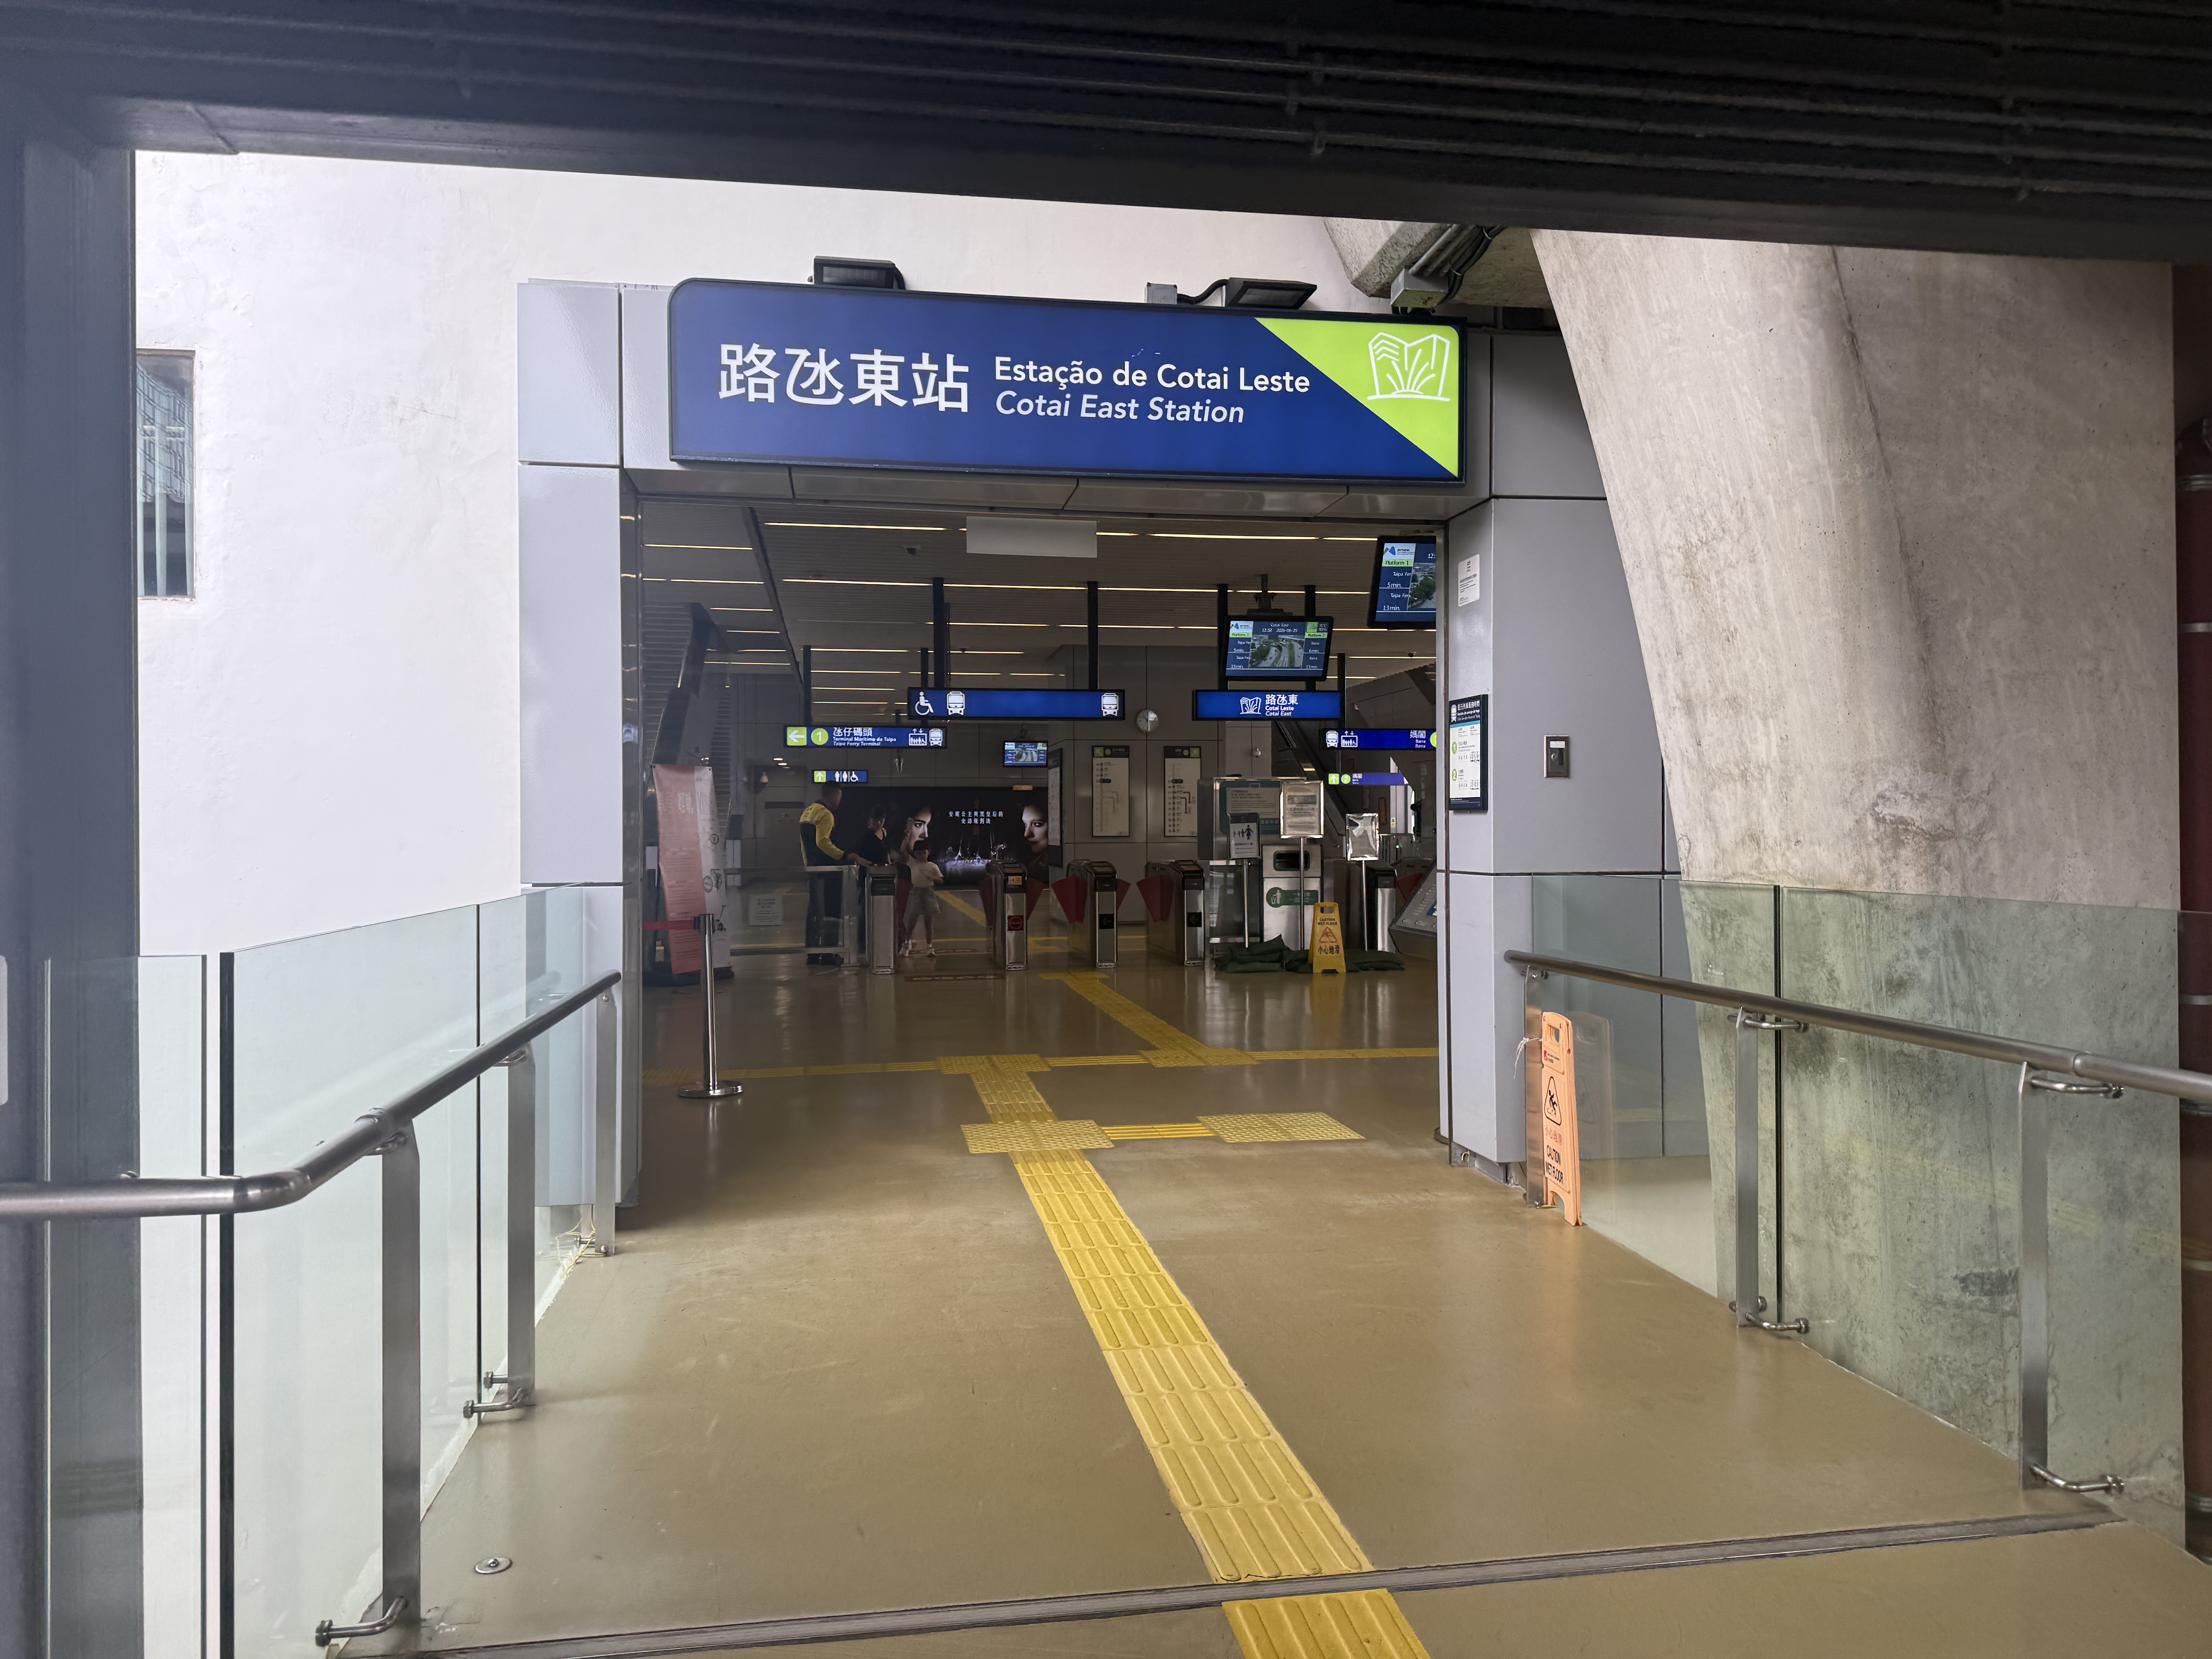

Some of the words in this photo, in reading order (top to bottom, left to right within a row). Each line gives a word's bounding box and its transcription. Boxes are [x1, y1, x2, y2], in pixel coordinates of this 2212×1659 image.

[719, 343, 969, 412] 路氹東站
[995, 356, 1103, 390] Estação
[1113, 361, 1147, 386] de
[1157, 364, 1229, 390] Cotai
[1240, 367, 1310, 393] Leste
[996, 390, 1071, 417] Cotai
[1080, 394, 1139, 419] East
[1147, 397, 1244, 423] Station
[1265, 694, 1298, 705] 路氹東
[816, 732, 821, 742] 1
[833, 727, 873, 737] 氹仔碼頭
[1410, 730, 1426, 738] 媽閣
